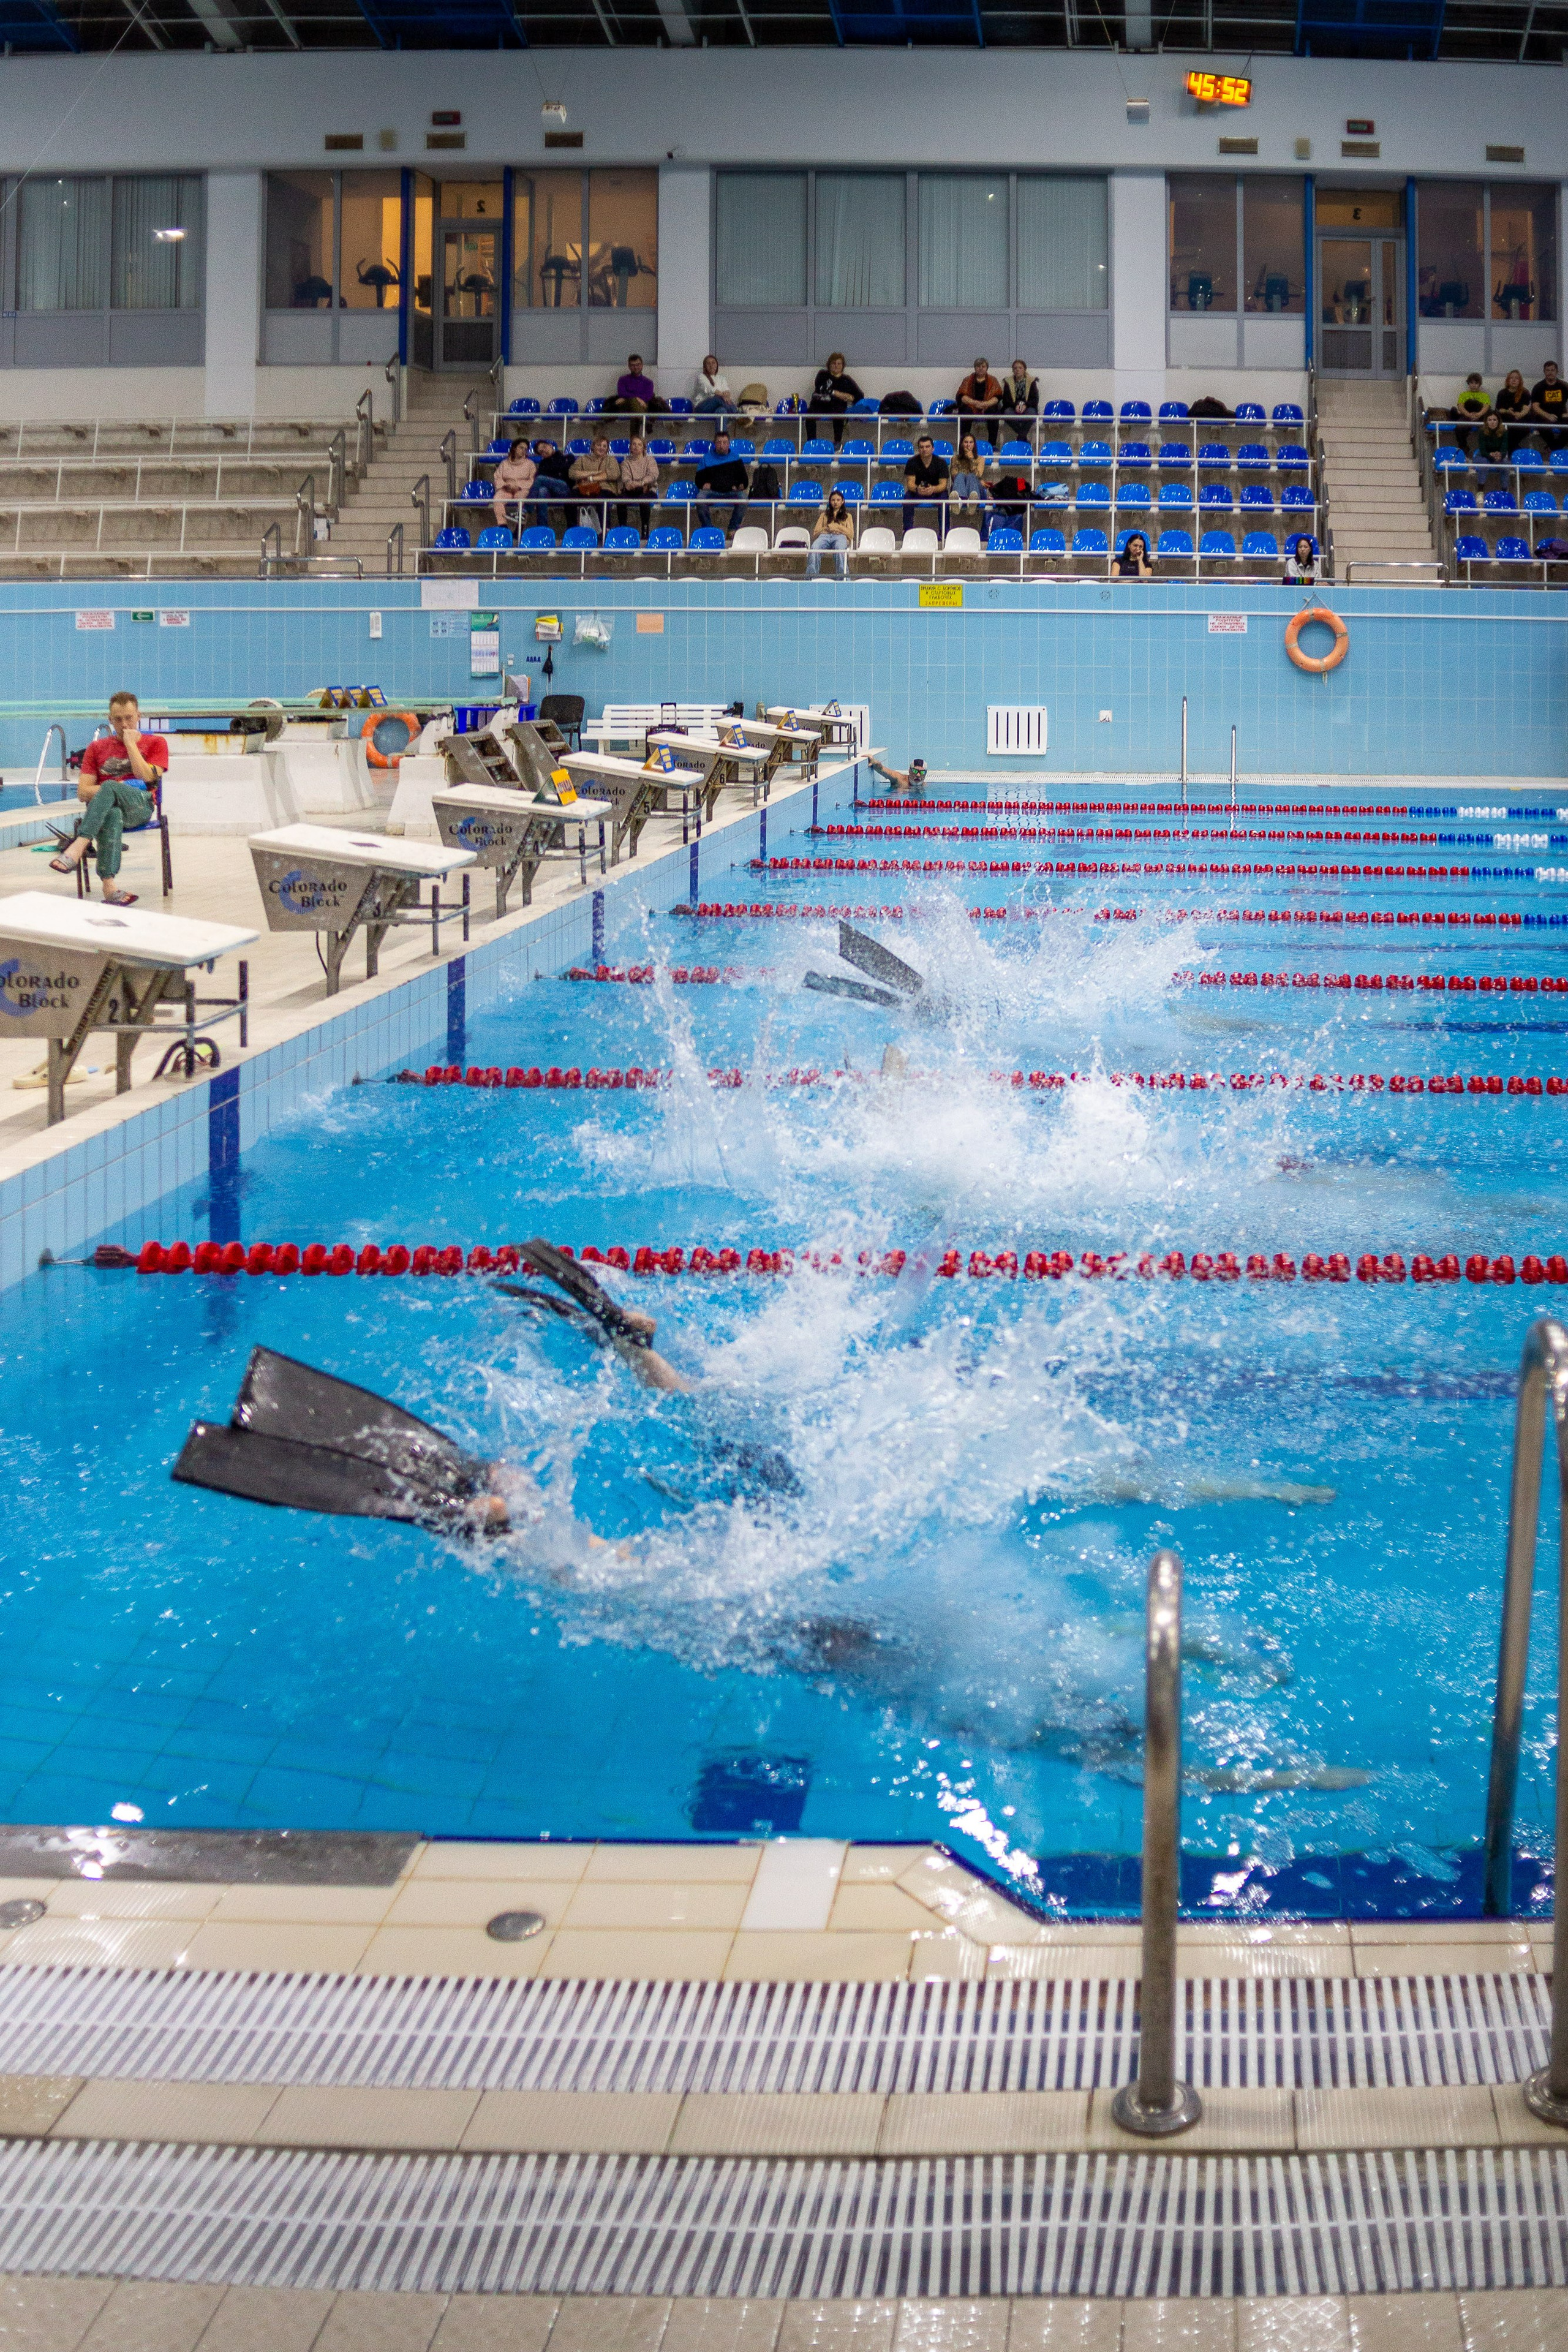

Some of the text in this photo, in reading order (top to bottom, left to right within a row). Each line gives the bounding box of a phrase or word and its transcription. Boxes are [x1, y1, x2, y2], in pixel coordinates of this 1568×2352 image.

[1189, 72, 1248, 102] 45:52
[821, 735, 825, 744] 8
[720, 773, 725, 784] 6
[644, 801, 650, 815] 5
[301, 894, 340, 908] Block
[19, 993, 69, 1008] Block
[108, 998, 119, 1023] 2
